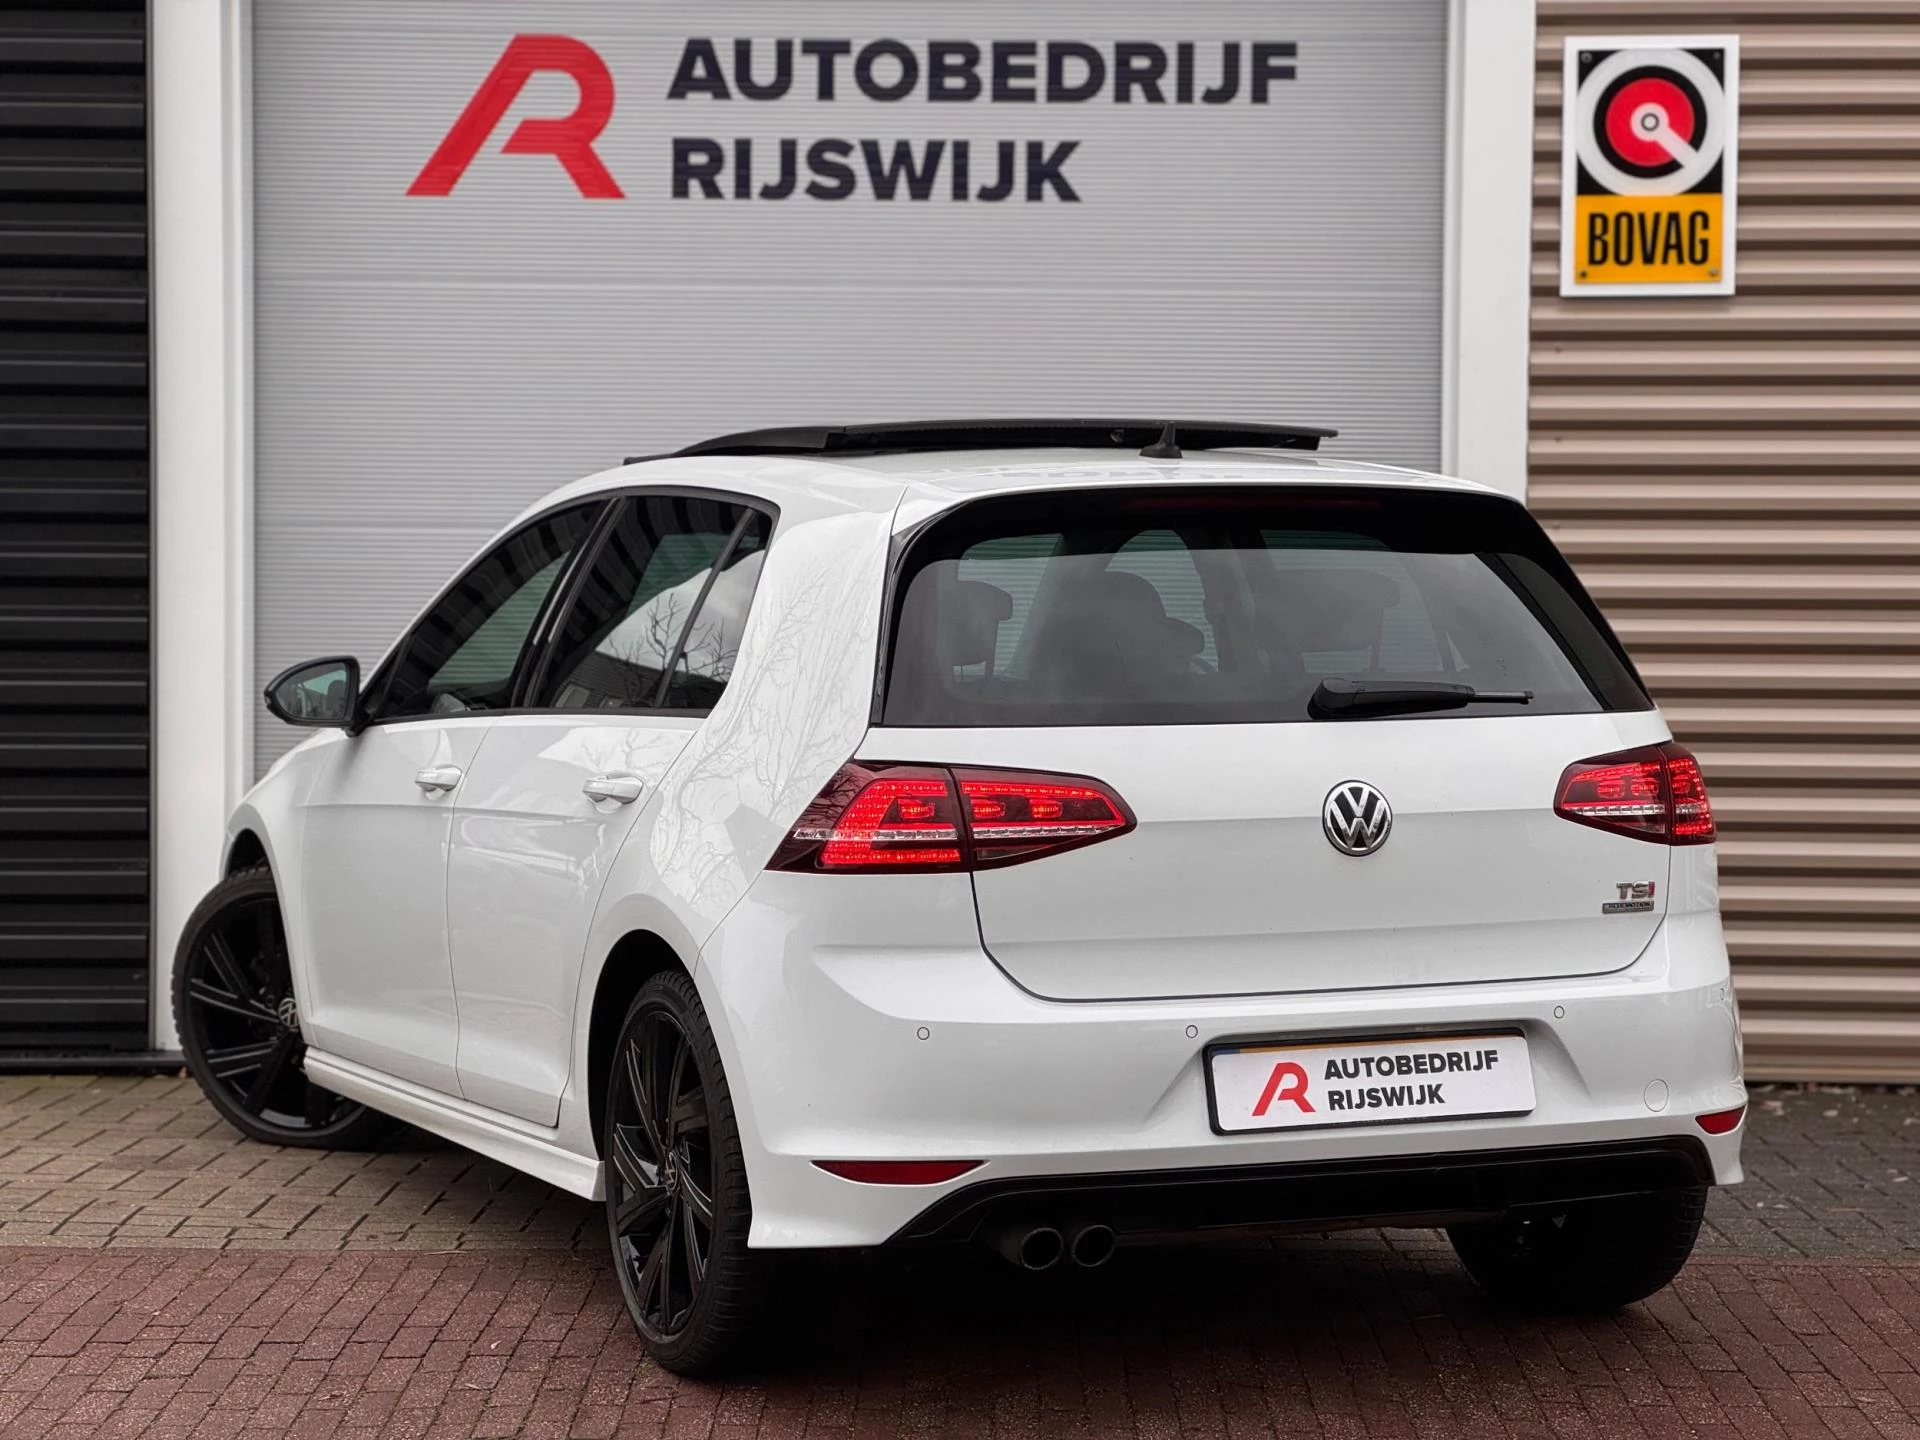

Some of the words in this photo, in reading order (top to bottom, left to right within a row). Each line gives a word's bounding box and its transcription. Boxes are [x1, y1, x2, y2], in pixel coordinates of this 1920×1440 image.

[667, 39, 1297, 104] AUTOBEDRIJF
[671, 138, 1081, 202] RIJSWIJK
[1588, 211, 1709, 266] BOVAG
[1616, 881, 1655, 900] TSI
[1324, 1050, 1499, 1080] AUTOBEDRIJF
[1327, 1083, 1445, 1111] RIJSWIJK
